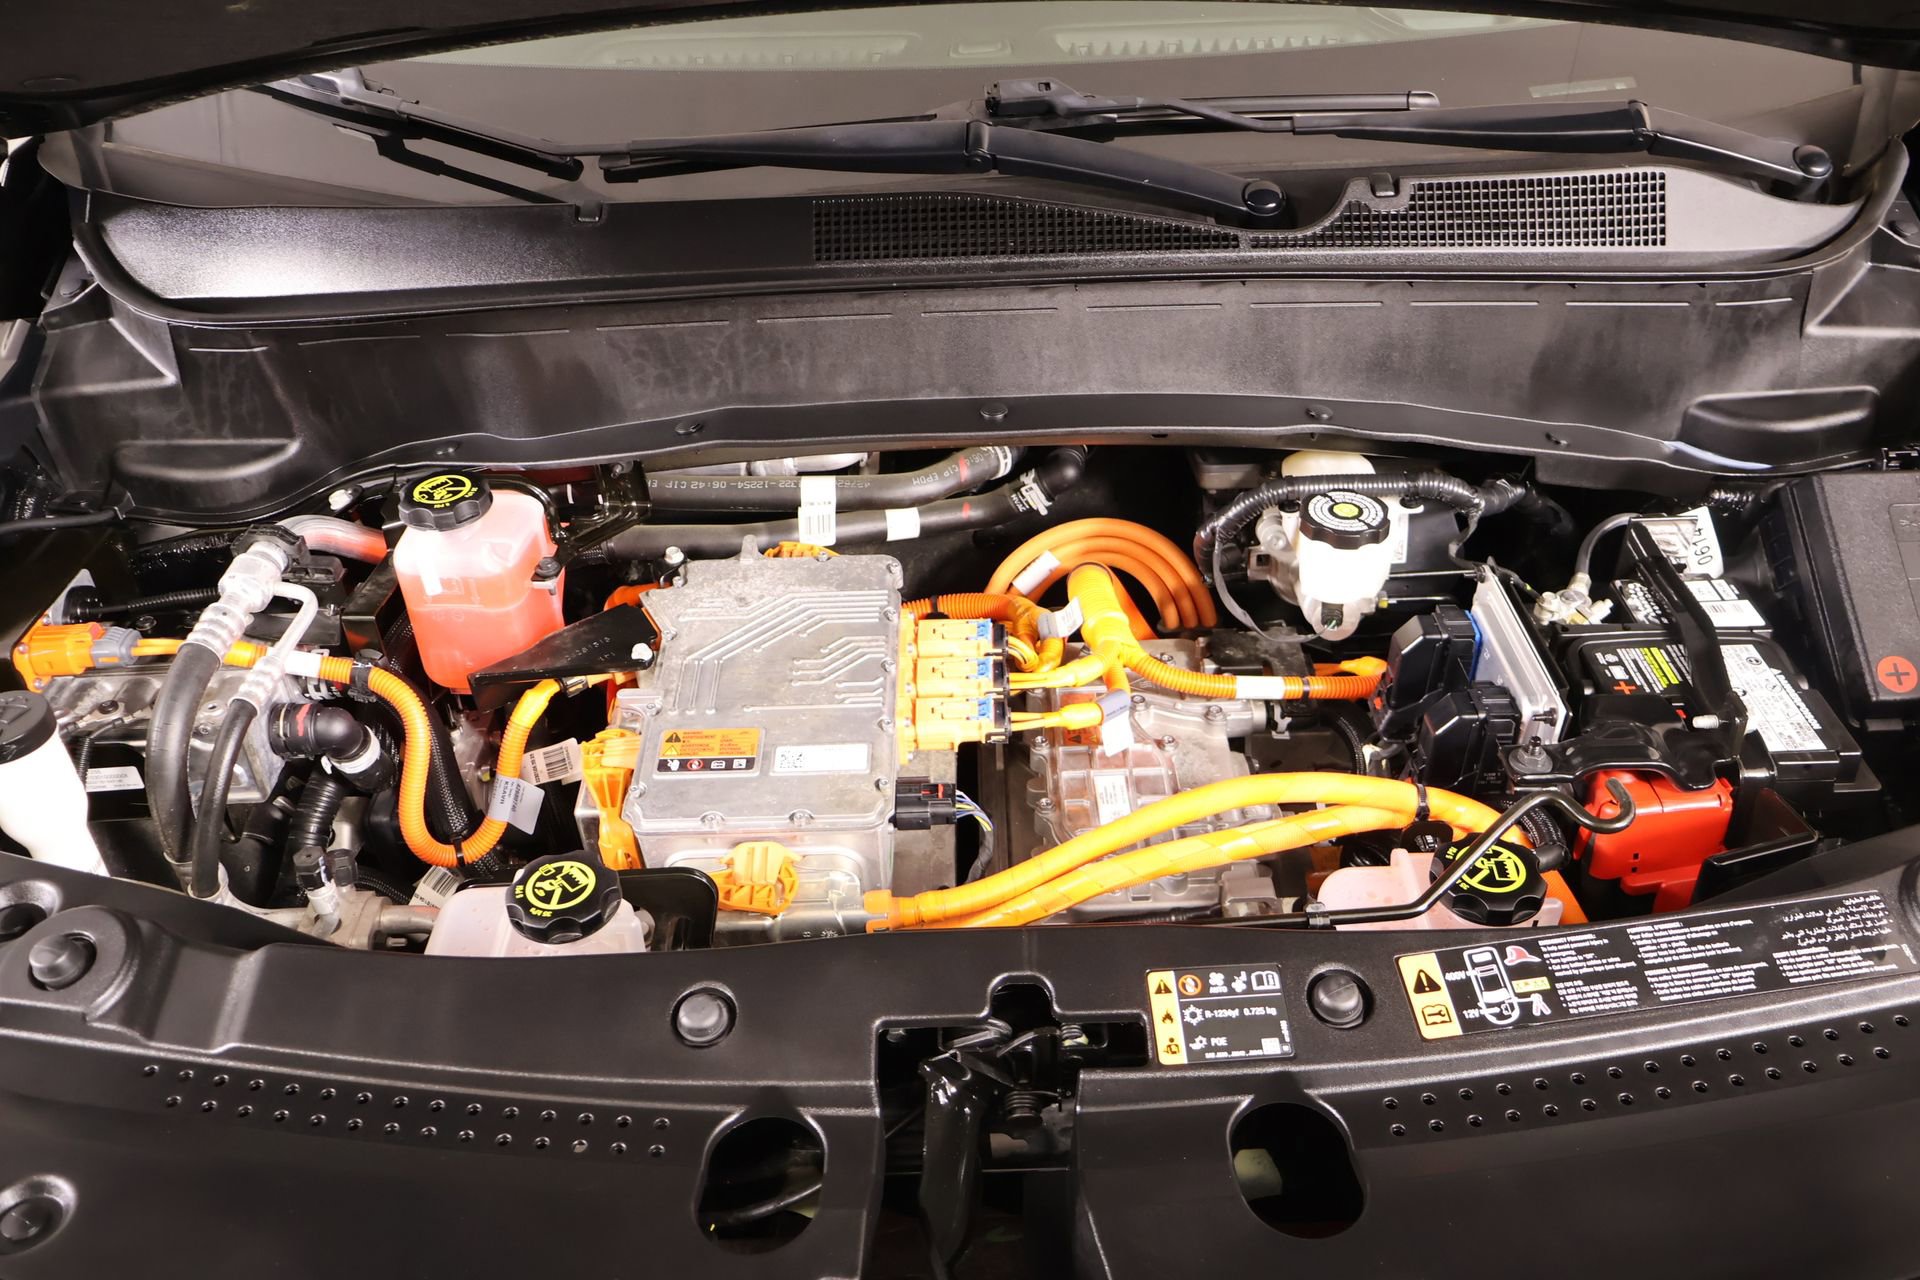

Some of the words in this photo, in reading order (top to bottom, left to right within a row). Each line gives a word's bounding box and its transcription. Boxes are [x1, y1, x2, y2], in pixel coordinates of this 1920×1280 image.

[1010, 493, 1027, 513] HVAC
[1209, 986, 1228, 994] AUTO
[1243, 1007, 1266, 1016] 0.725
[1265, 1006, 1278, 1016] kg
[1462, 1008, 1480, 1019] 12V
[1210, 1037, 1228, 1047] POE
